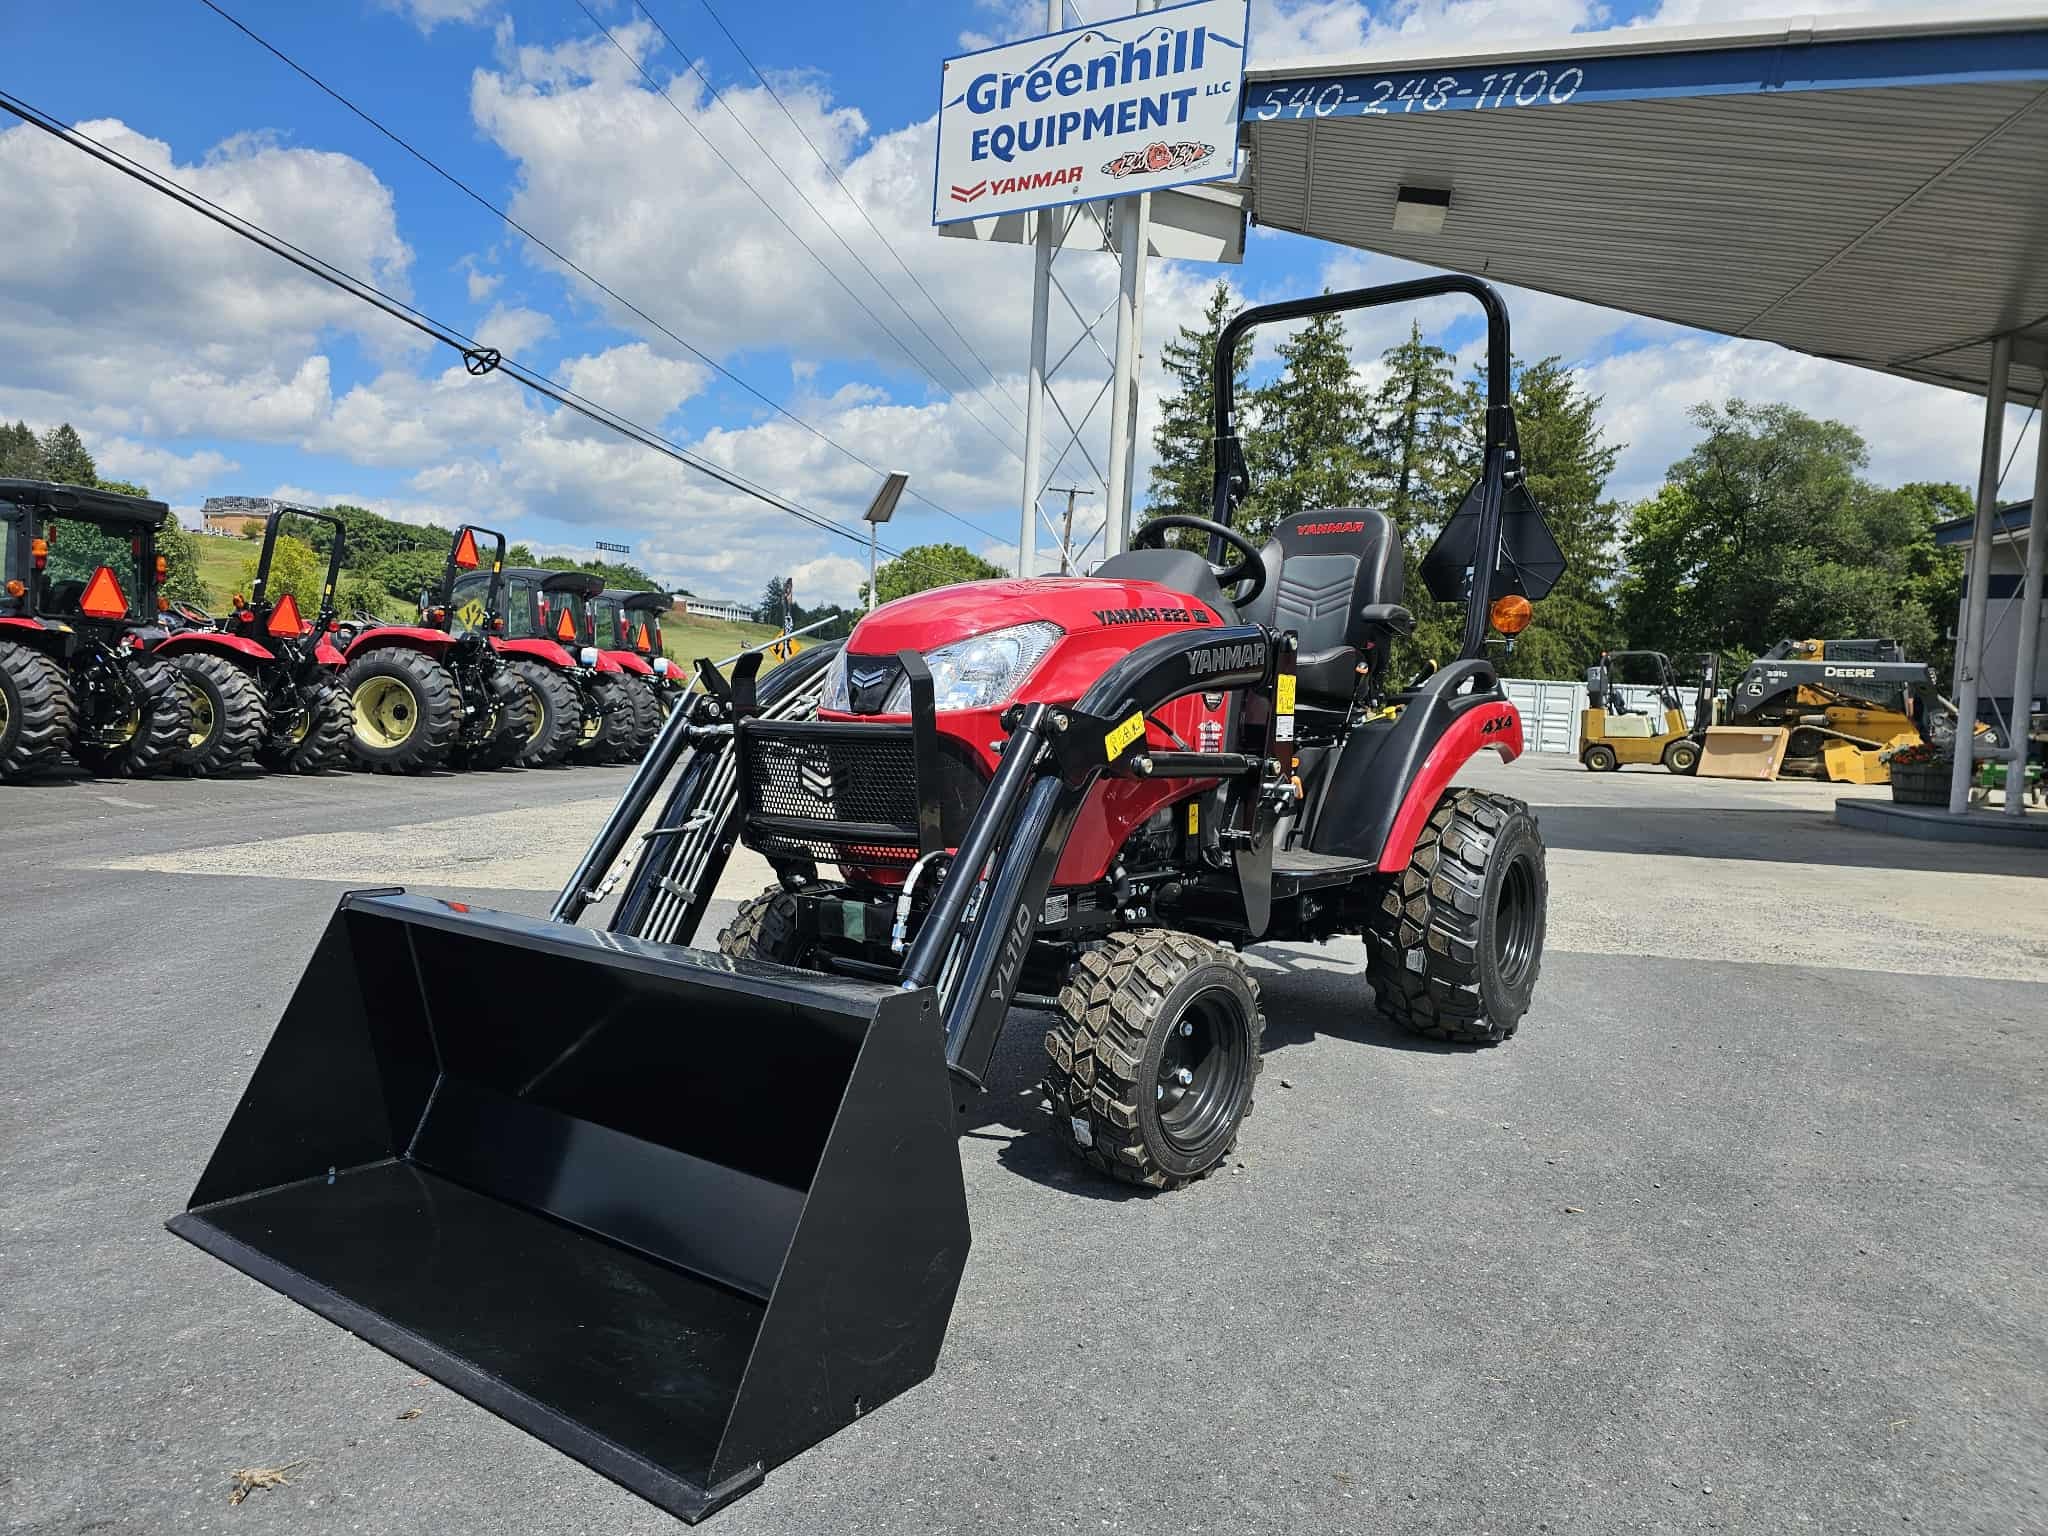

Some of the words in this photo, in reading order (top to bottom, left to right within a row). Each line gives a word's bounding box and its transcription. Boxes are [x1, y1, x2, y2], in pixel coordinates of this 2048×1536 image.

[966, 26, 1206, 115] Greenhill
[1257, 67, 1584, 121] 540-248-1100
[971, 87, 1198, 163] EQUIPMENT
[1205, 80, 1232, 96] LLC
[990, 166, 1084, 196] YANMAR
[1297, 521, 1365, 536] YANMAR
[1091, 608, 1160, 626] YANMAR
[1185, 642, 1265, 675] YANMAR
[1825, 666, 1876, 678] DEERE
